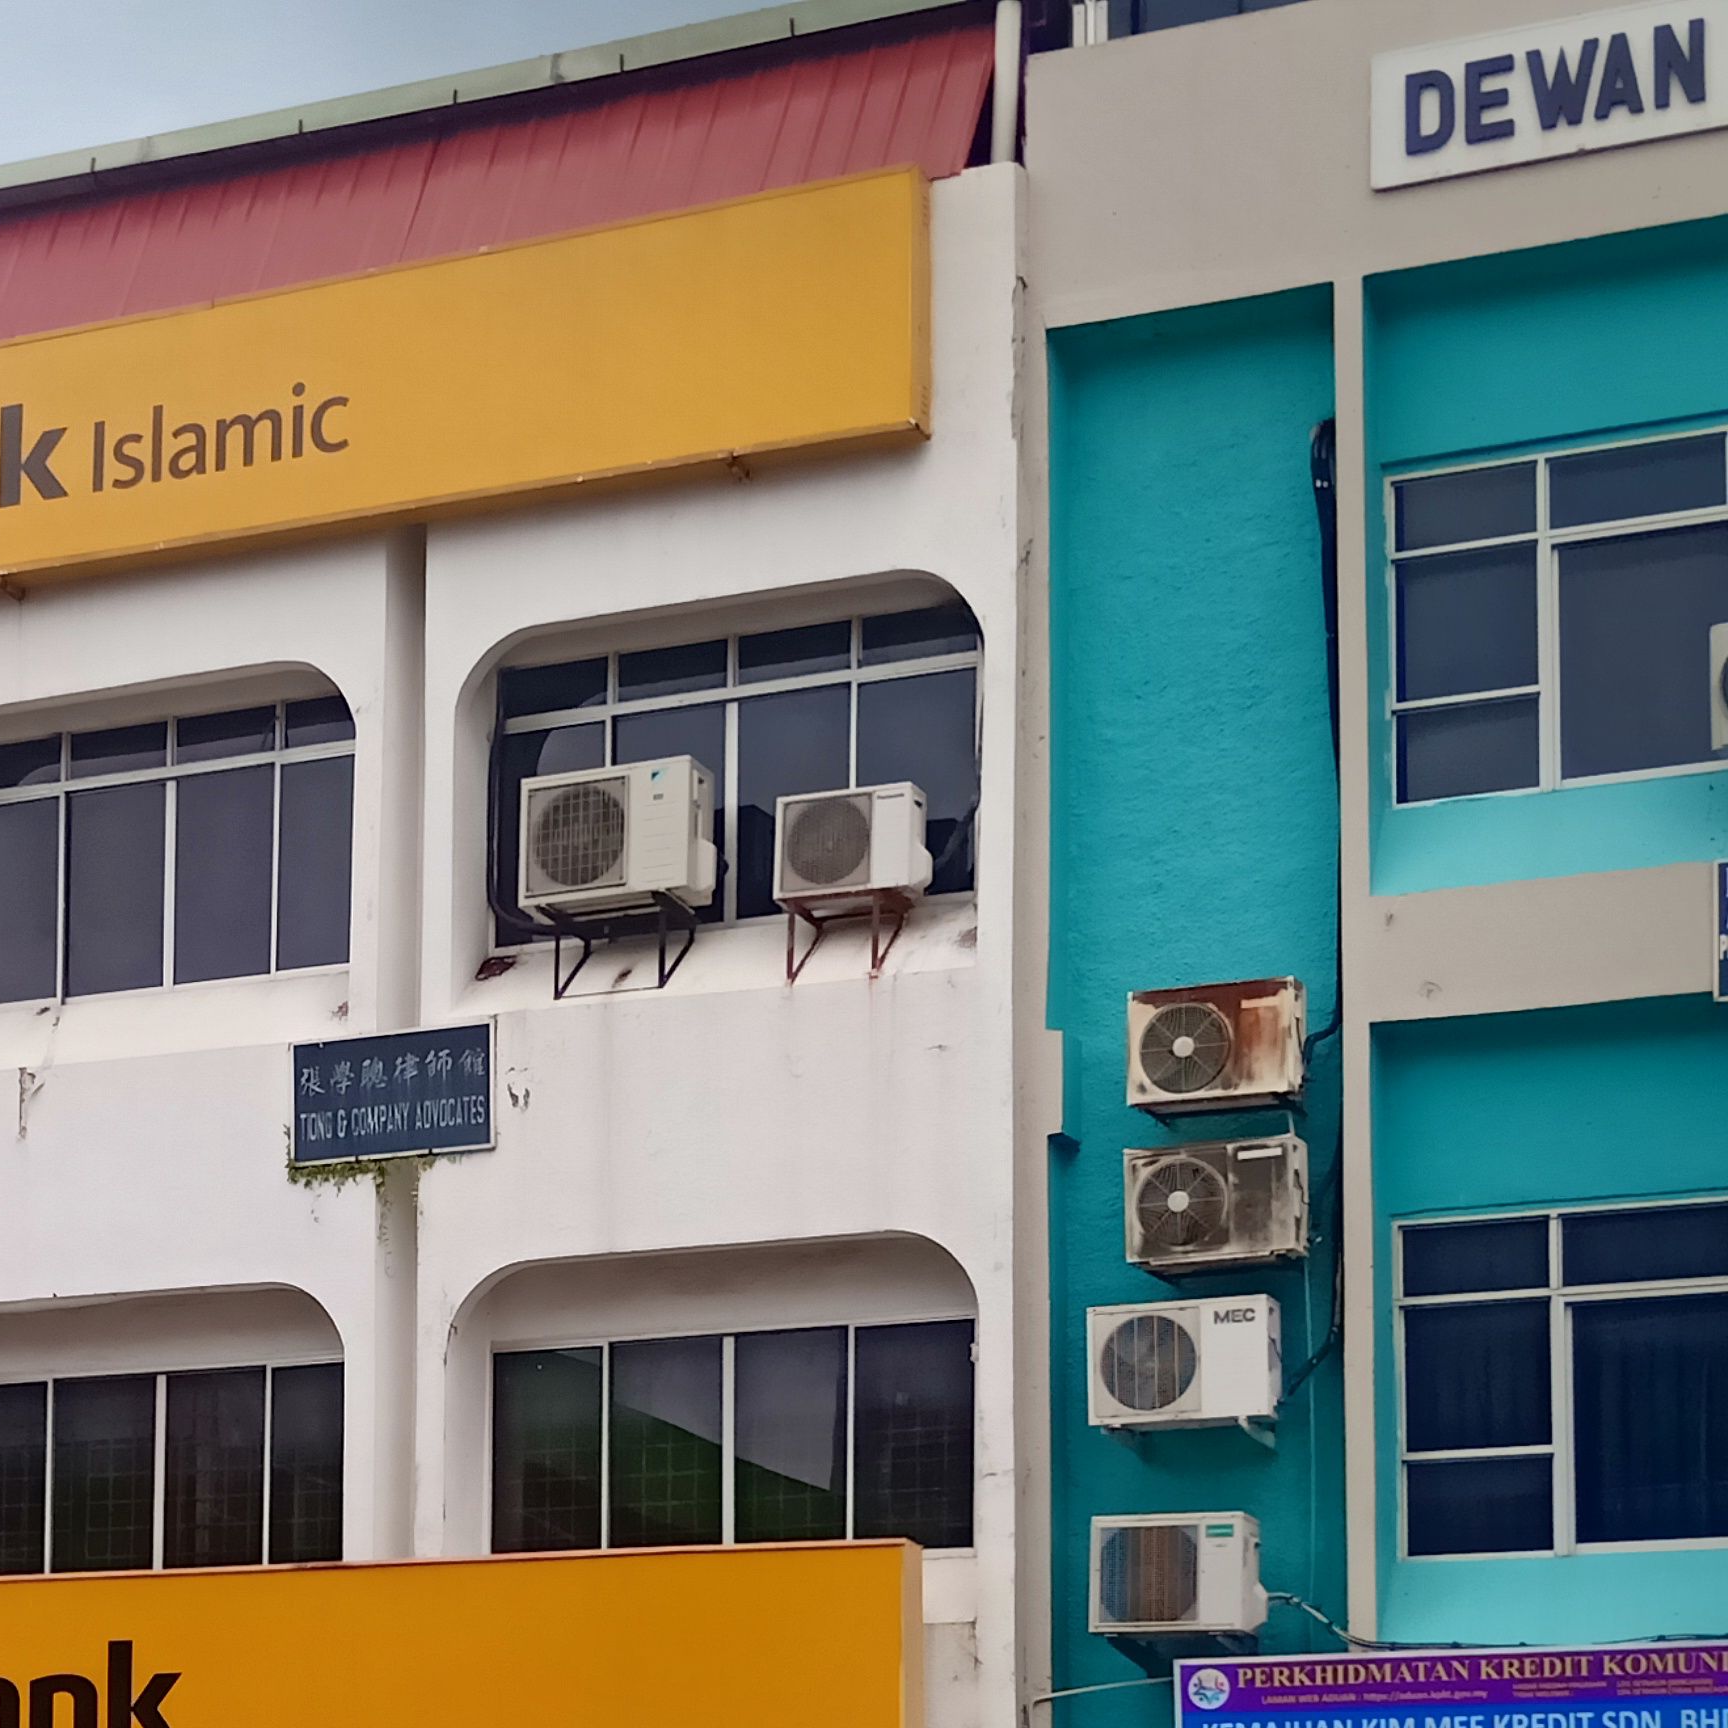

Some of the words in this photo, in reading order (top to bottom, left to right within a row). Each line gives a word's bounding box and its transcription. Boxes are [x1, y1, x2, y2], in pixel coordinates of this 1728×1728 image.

[1405, 18, 1706, 155] DEWAN
[91, 382, 349, 494] Islamic
[337, 1109, 347, 1138] &
[351, 1102, 409, 1135] COMPANY
[415, 1095, 485, 1129] ADVOCATES
[1213, 1307, 1256, 1325] MEC
[1237, 1661, 1469, 1688] PERKHIDMATAN
[1480, 1655, 1594, 1680] KREDIT
